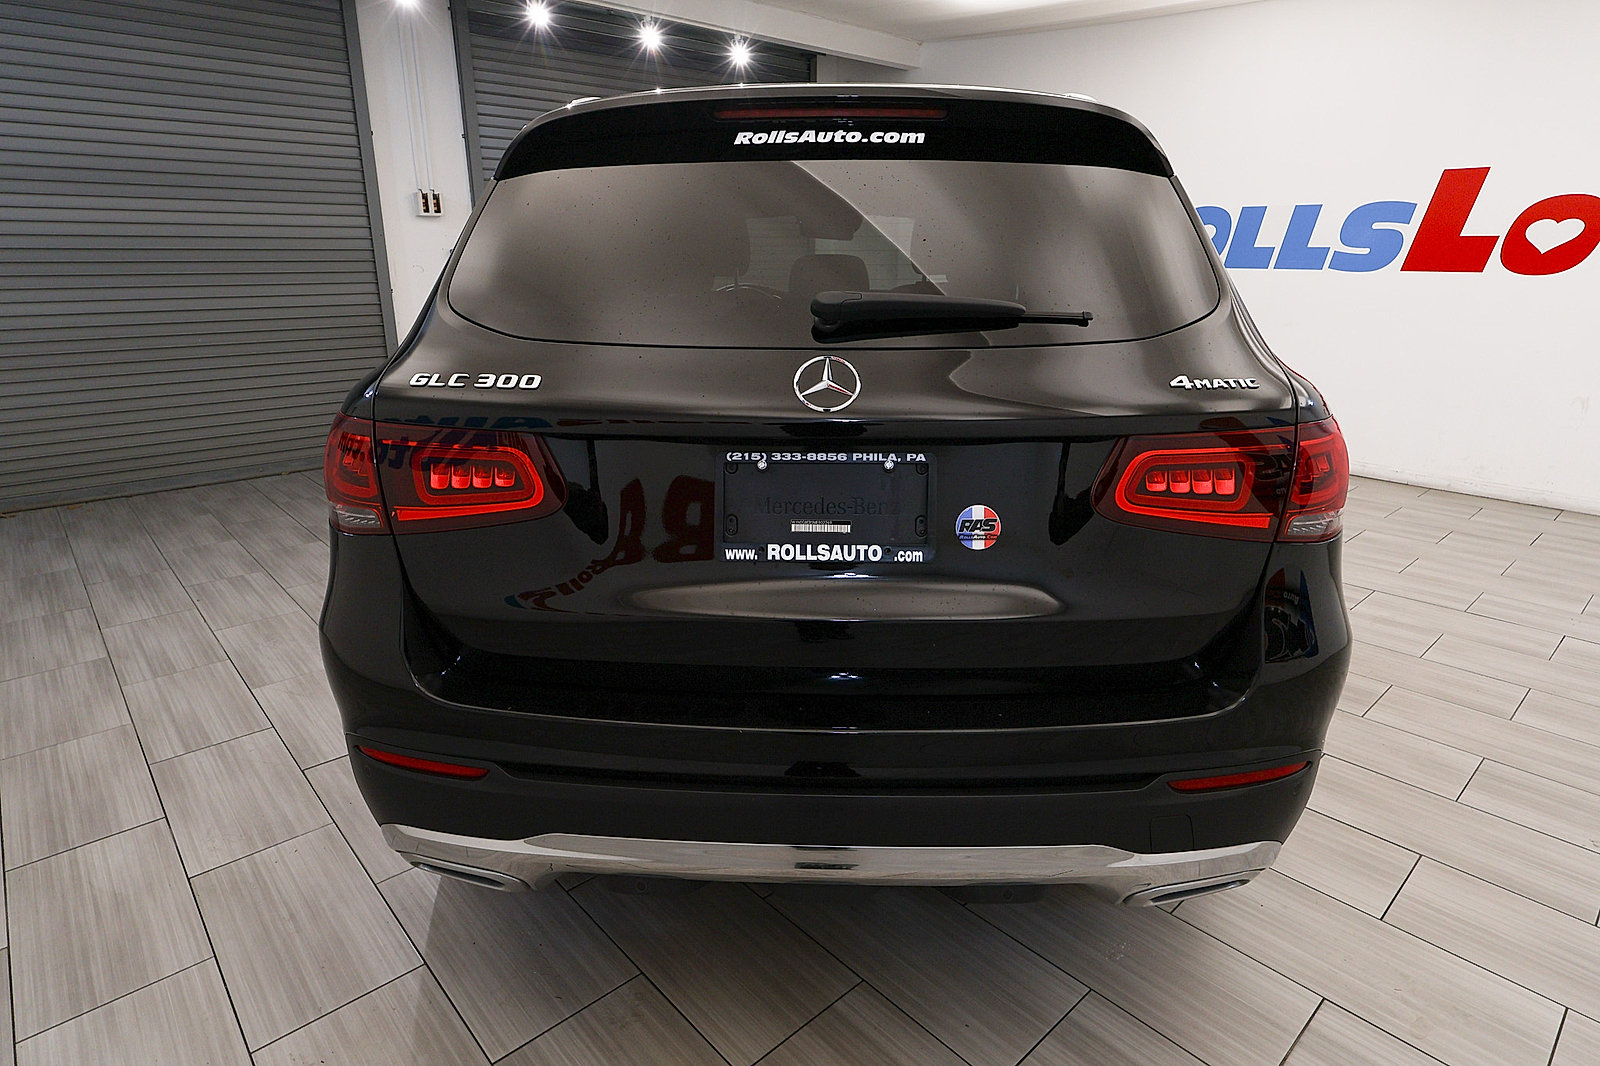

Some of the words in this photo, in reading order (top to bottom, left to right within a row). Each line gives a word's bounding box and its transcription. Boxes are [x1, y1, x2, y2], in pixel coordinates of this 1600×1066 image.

[734, 129, 925, 145] RollsAuto.com
[408, 372, 470, 388] GLC
[473, 374, 542, 389] 300
[1169, 374, 1261, 390] 4MATIC
[726, 452, 767, 462] (215)
[771, 452, 848, 462] 333-8856
[852, 452, 902, 463] PHILA,
[906, 453, 927, 462] PA
[958, 518, 998, 533] RAS
[725, 549, 758, 560] www.
[767, 544, 883, 562] ROLLSAUTO
[893, 549, 924, 563] .com
